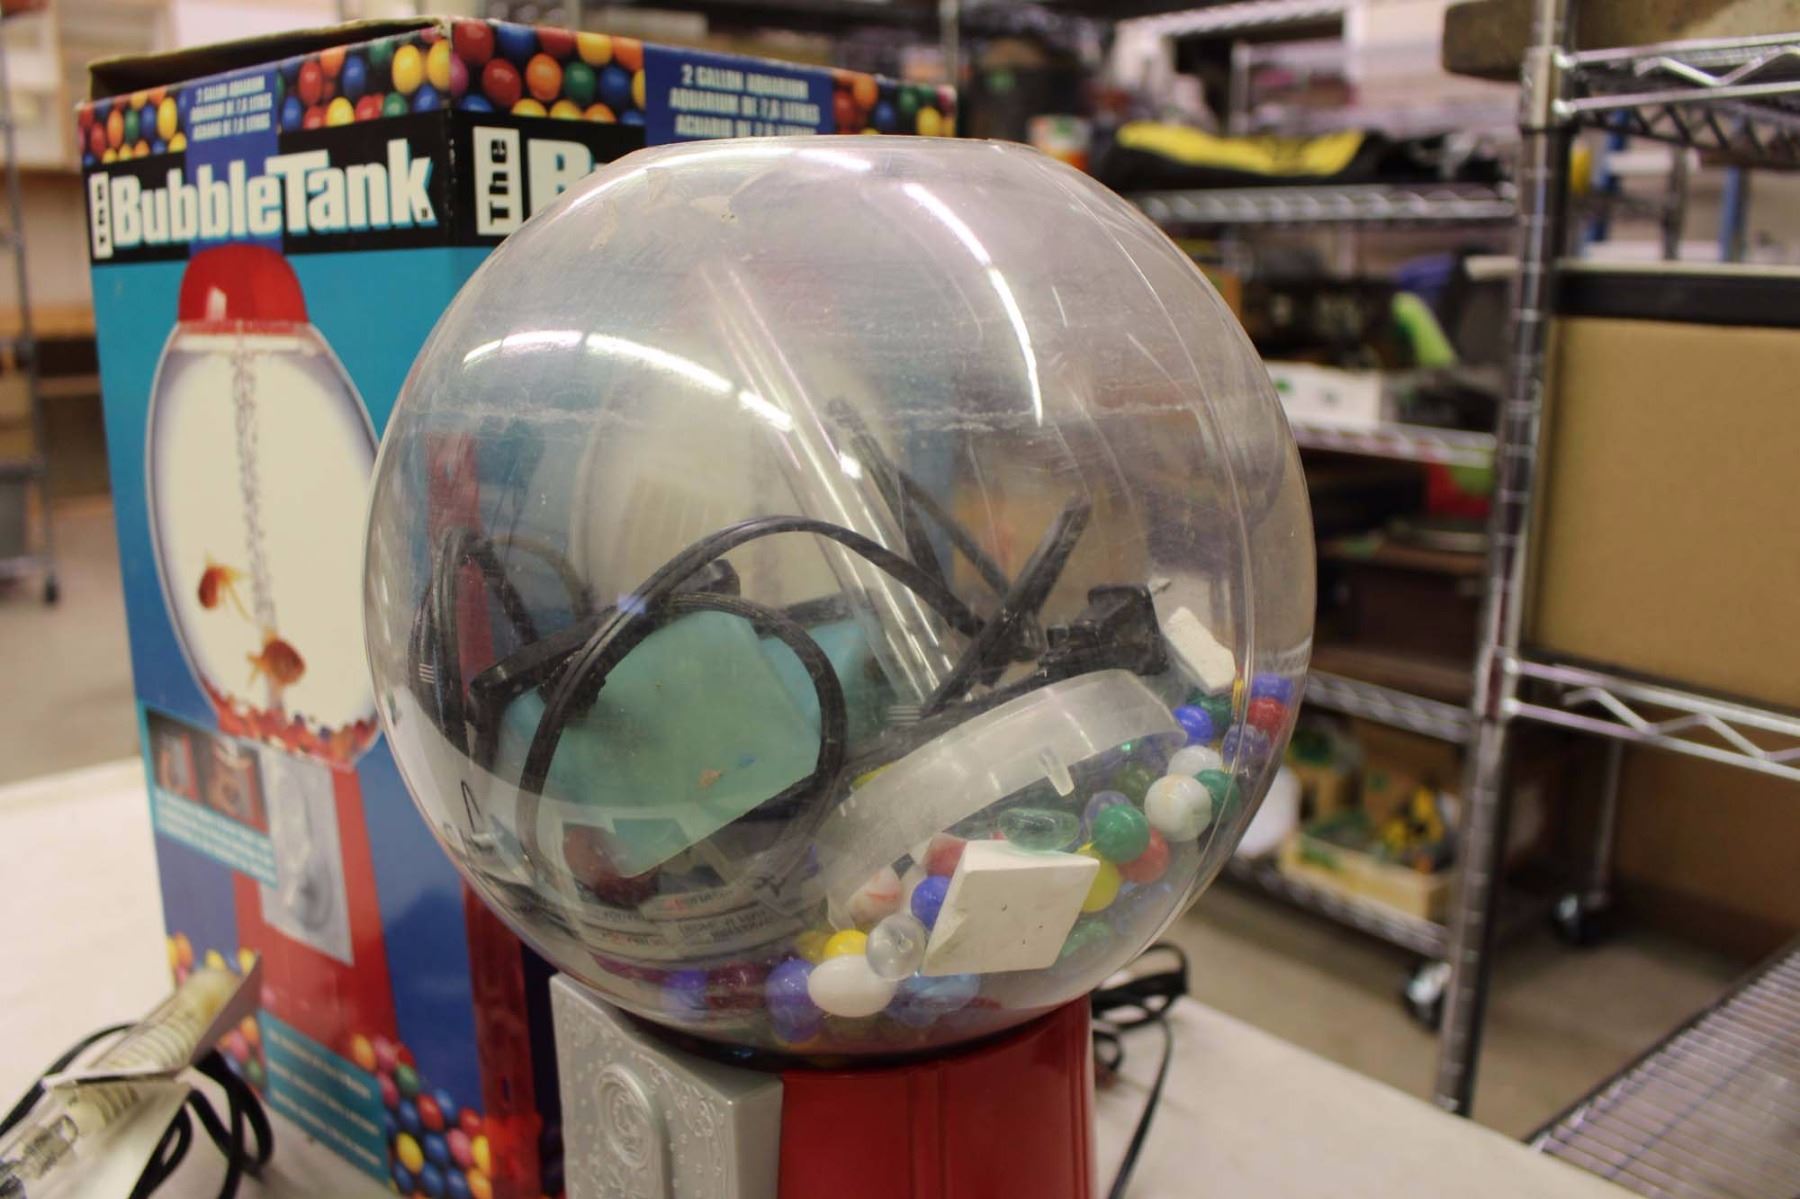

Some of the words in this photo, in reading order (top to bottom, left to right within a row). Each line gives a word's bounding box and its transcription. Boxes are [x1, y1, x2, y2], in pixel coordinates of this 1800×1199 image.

[681, 64, 694, 86] 2
[111, 138, 438, 248] BubbleTank
[488, 138, 511, 226] The
